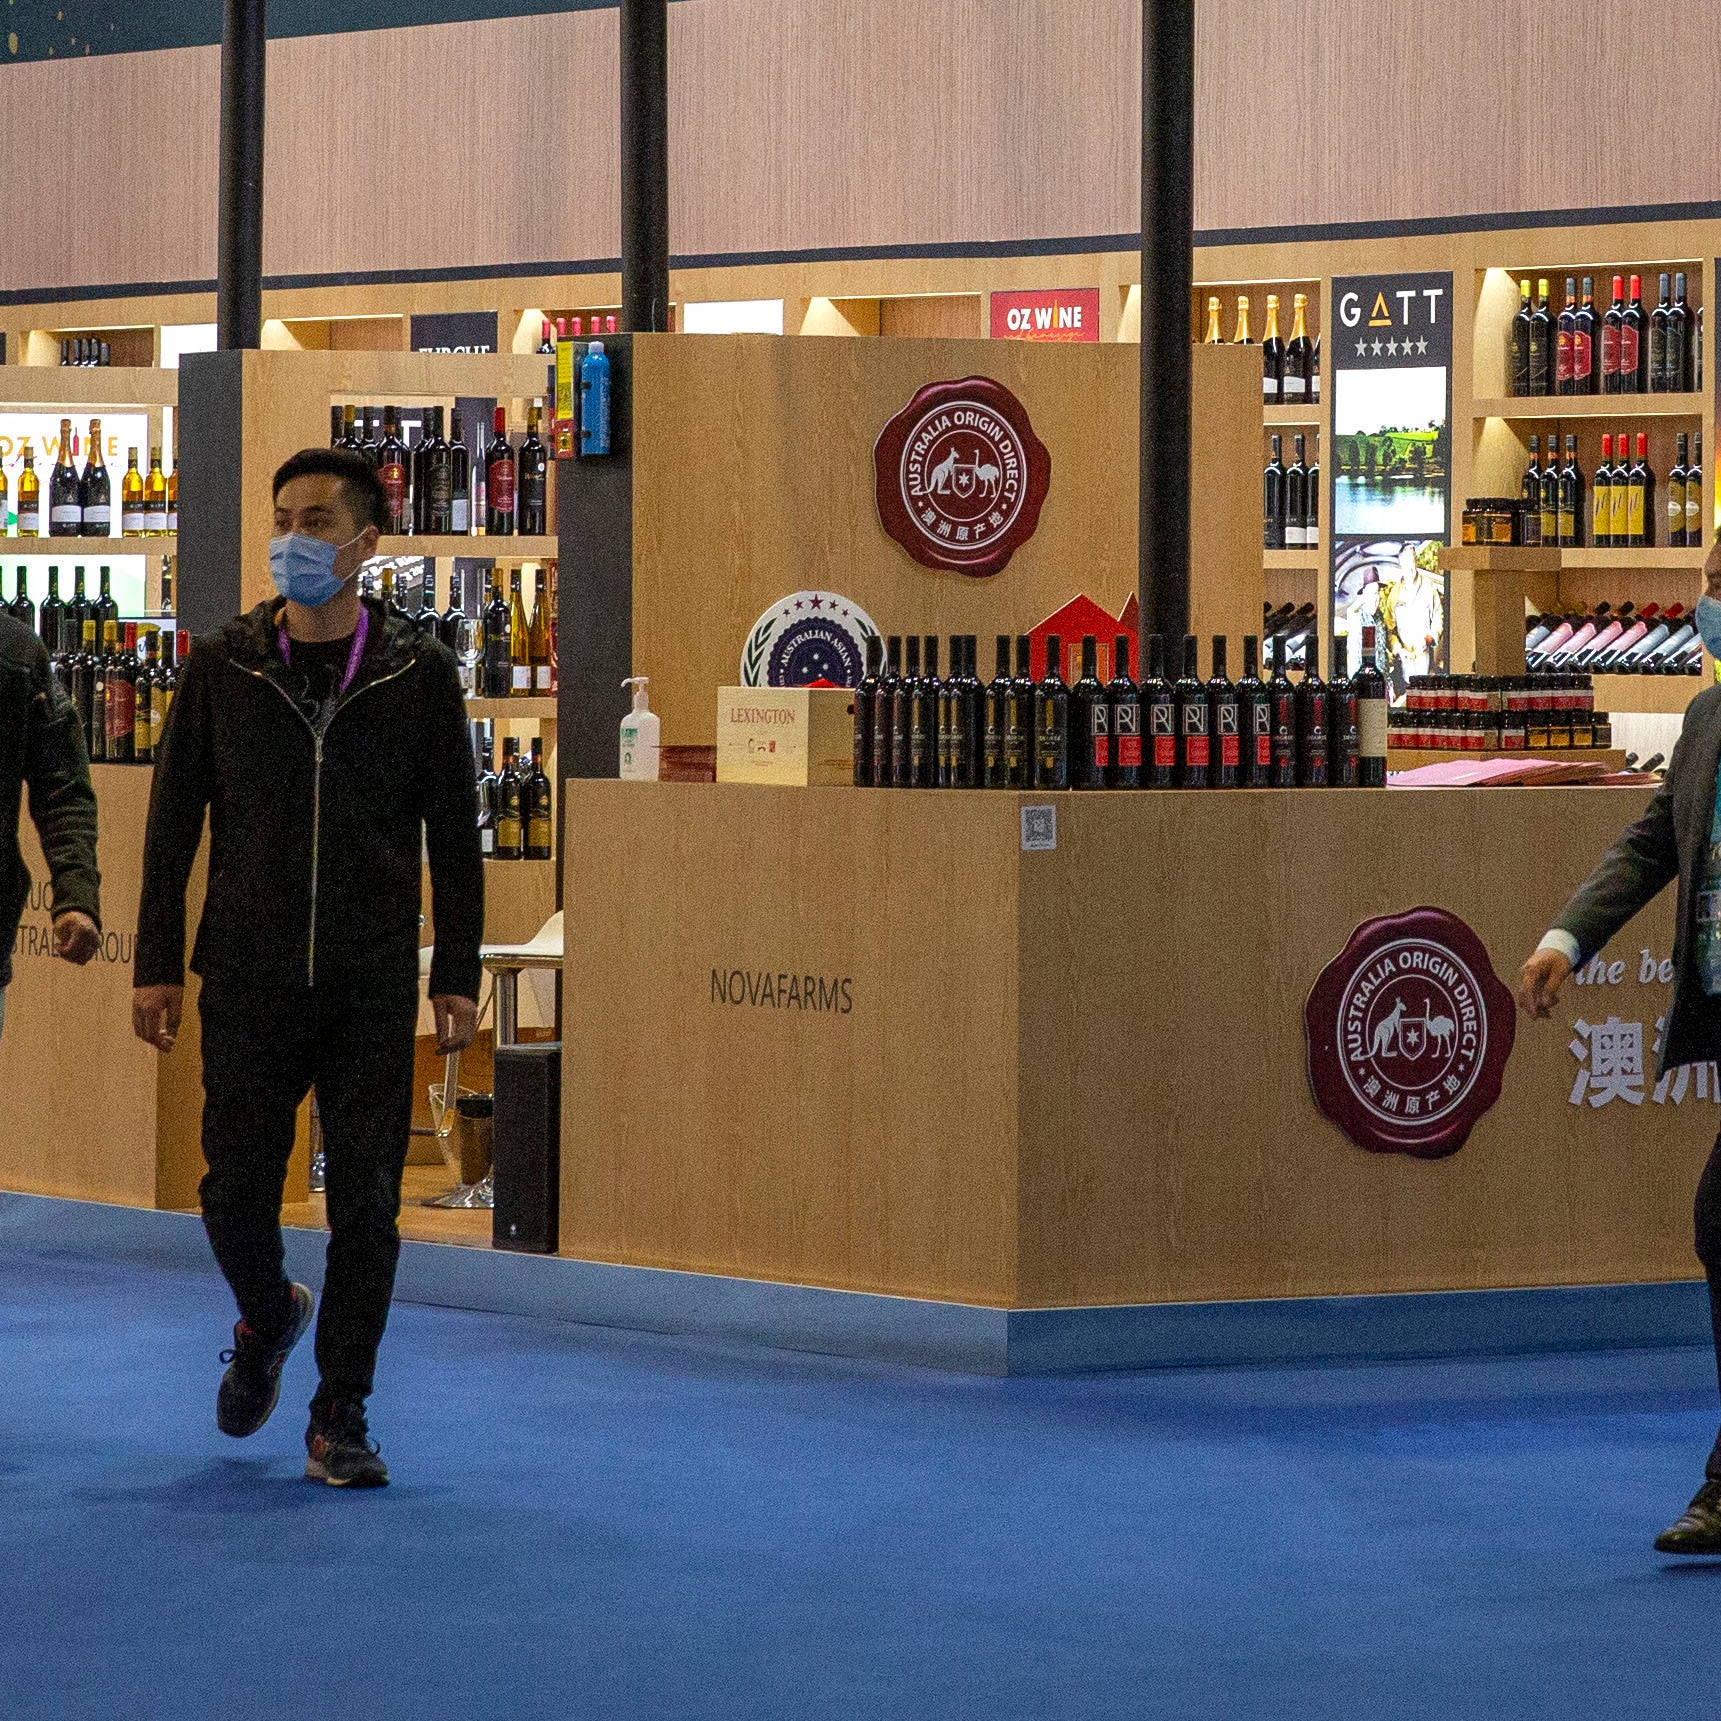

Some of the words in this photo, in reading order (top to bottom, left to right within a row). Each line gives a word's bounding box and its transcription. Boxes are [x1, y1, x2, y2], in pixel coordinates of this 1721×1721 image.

[1007, 307, 1032, 331] OZ
[1339, 287, 1445, 329] GATT
[908, 414, 952, 496] AUSTRALIA
[953, 410, 1004, 442] ORIGIN
[998, 439, 1020, 503] DIRECT
[780, 628, 834, 667] AUSTRALIAN
[830, 638, 854, 668] ASIAN
[729, 707, 797, 725] LEXINGTON
[709, 968, 854, 1015] NOVAFARMS
[1347, 958, 1397, 1062] AUSTRALIA
[1398, 951, 1459, 987] ORIGIN
[1452, 983, 1478, 1062] DIRECT
